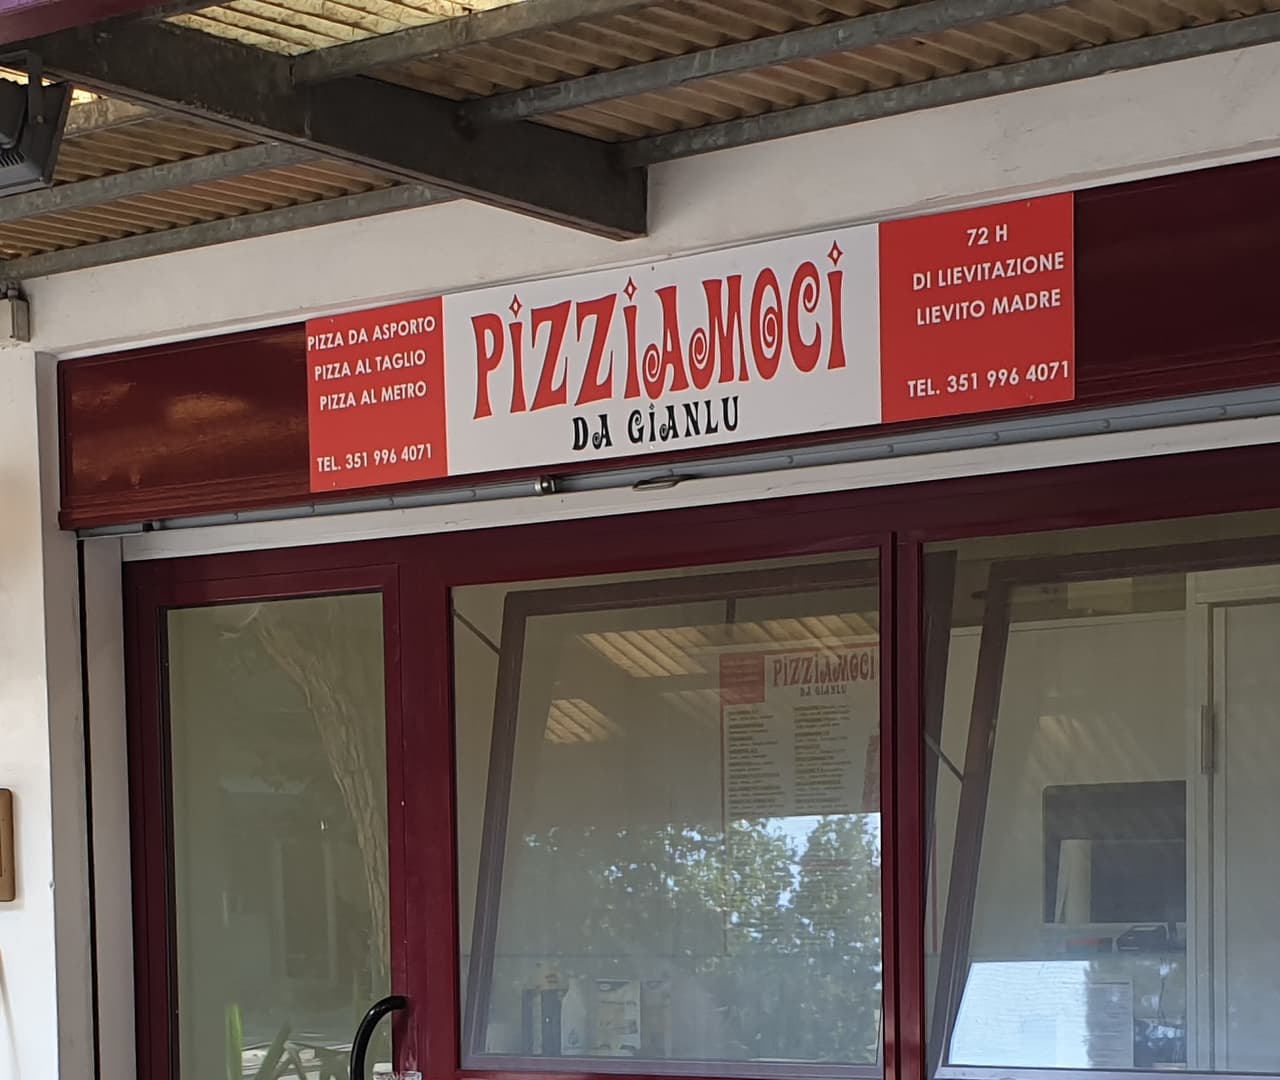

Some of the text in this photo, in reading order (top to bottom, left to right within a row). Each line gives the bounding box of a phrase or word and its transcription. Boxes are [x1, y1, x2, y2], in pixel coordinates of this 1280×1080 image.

[967, 224, 1008, 246] 72 H
[913, 251, 1065, 290] DI LIEVITAZIONE
[917, 289, 1061, 326] LIEVITO MADRE
[307, 316, 436, 351] PIZZA DA ASPORTO
[315, 349, 426, 381] PIZZA AL TAGLIO
[908, 360, 1069, 397] TEL. 351 996 4071
[320, 381, 427, 411] PIZZA AL METRO
[572, 396, 739, 450] DA GIANLU
[317, 443, 432, 472] TEL. 351 996 4071
